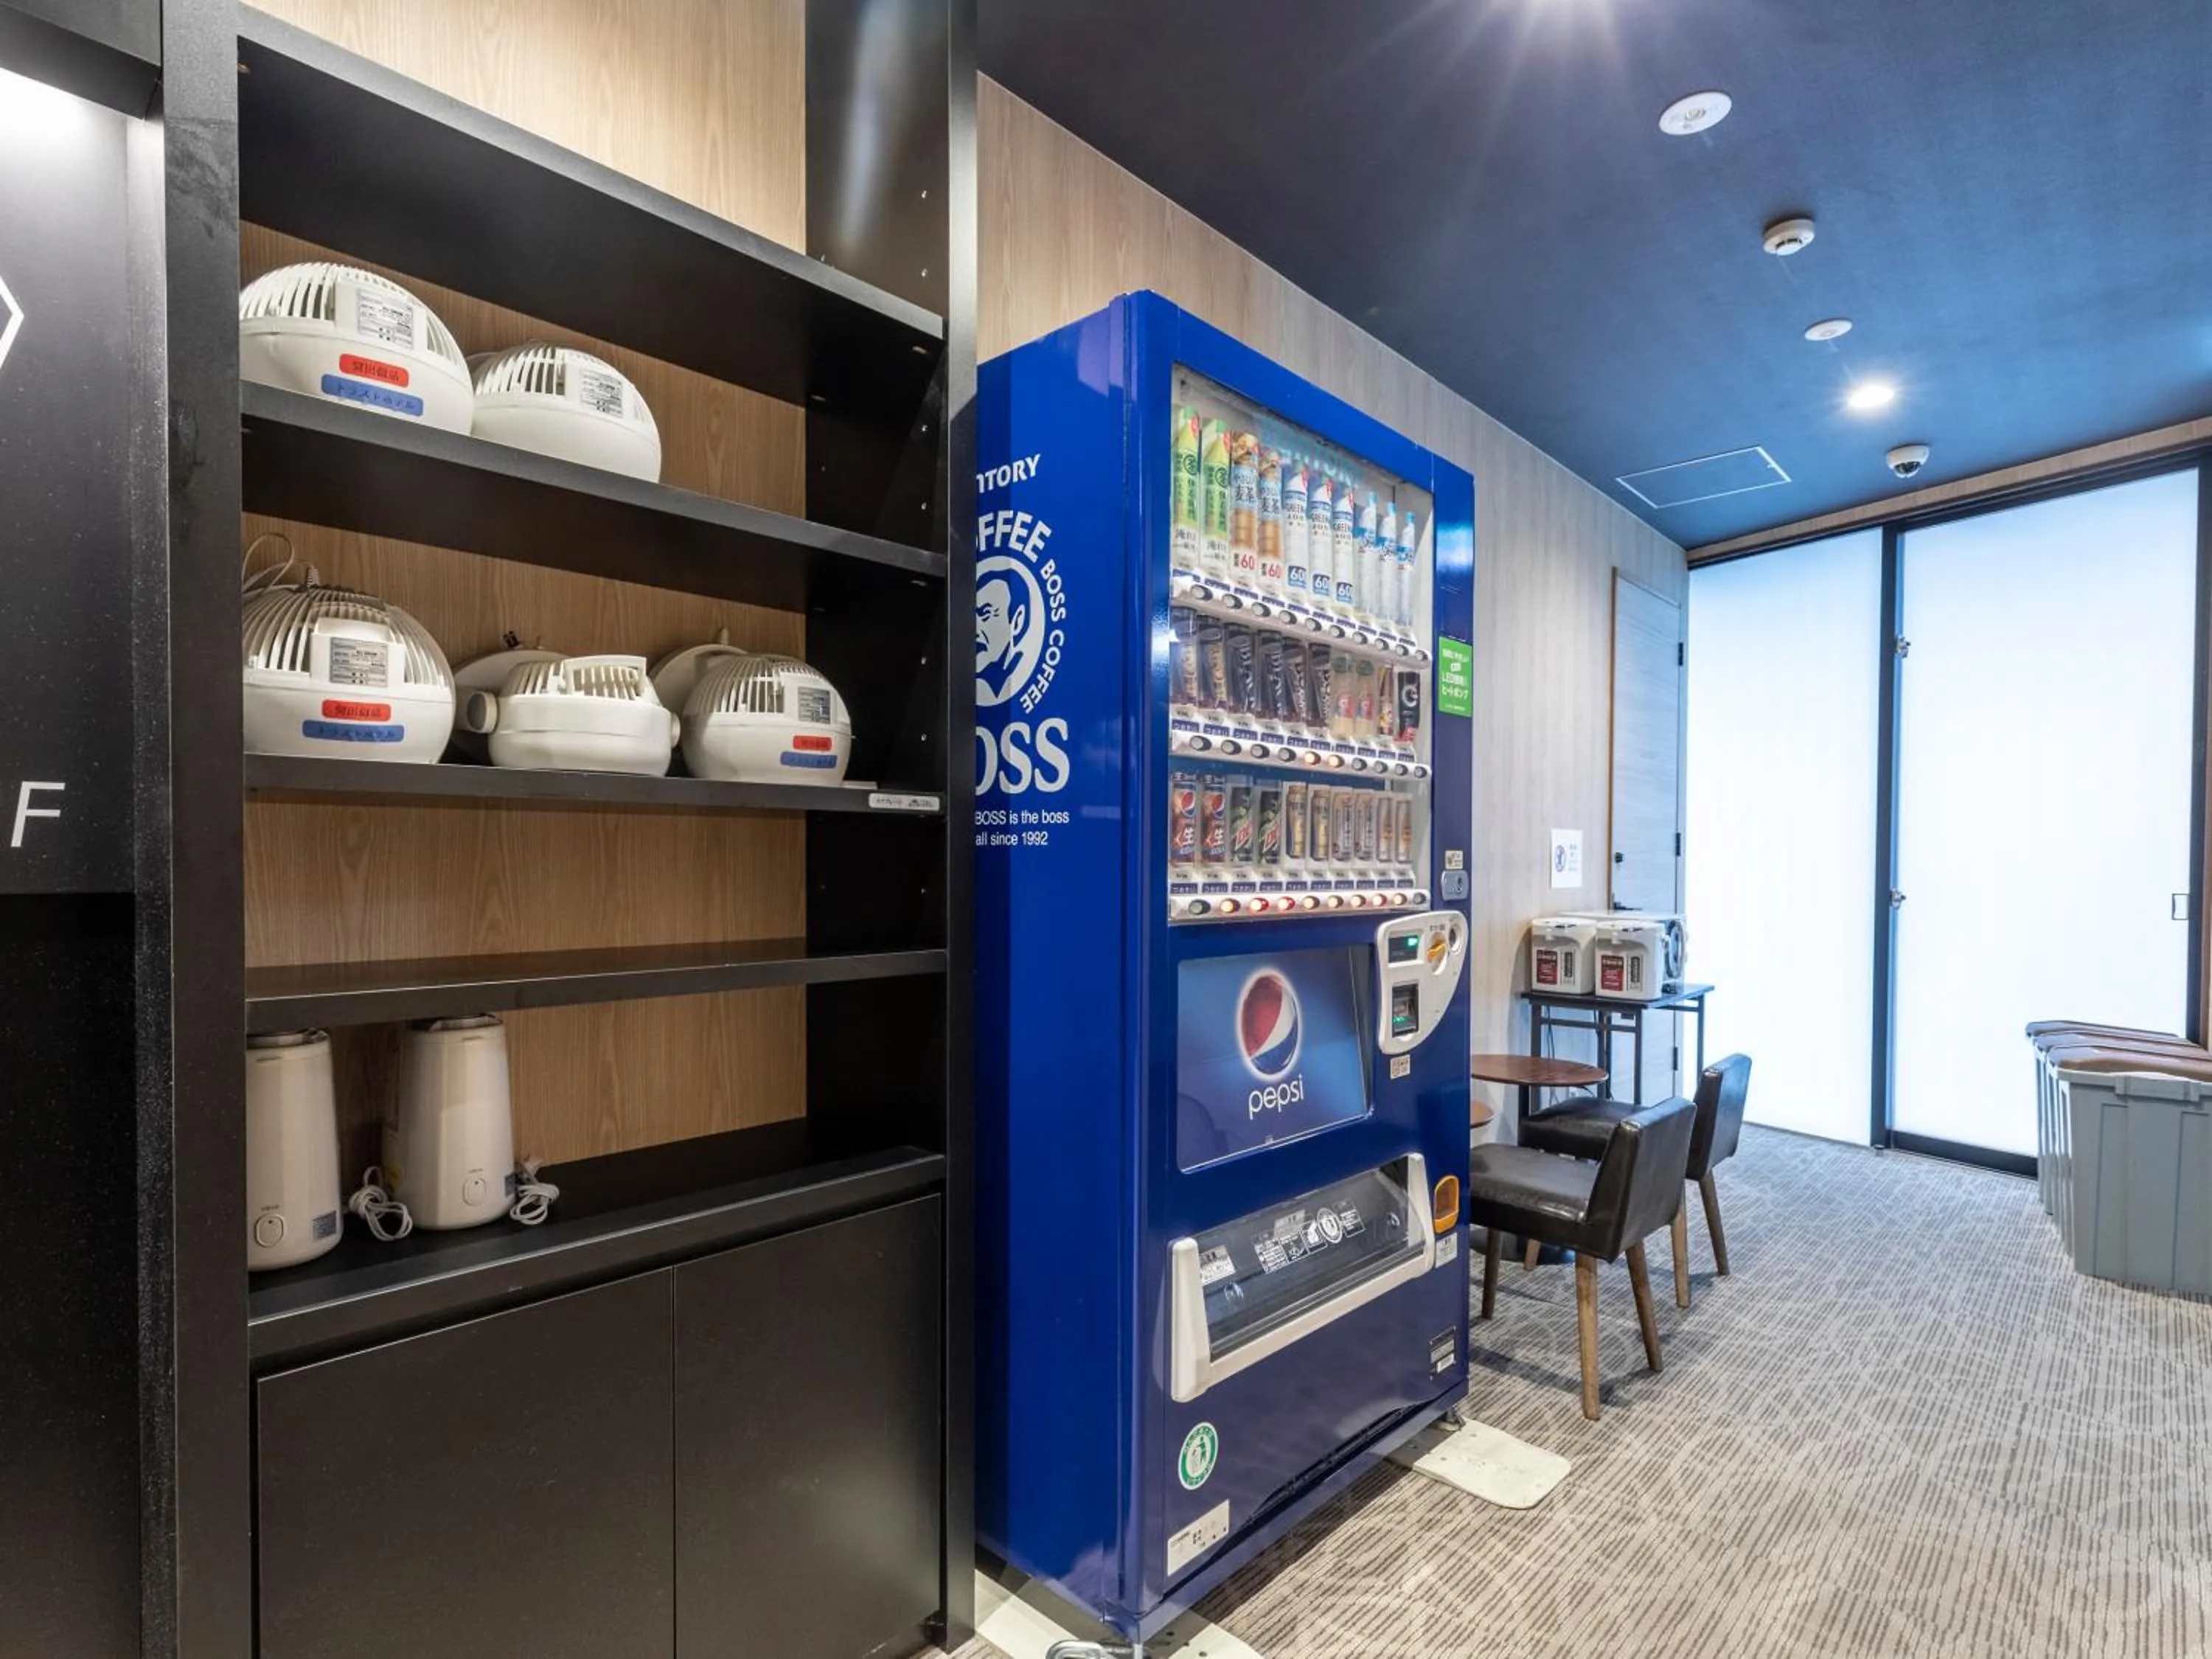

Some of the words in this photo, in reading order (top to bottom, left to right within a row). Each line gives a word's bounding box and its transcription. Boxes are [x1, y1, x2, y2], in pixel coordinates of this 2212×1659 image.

[975, 509, 1052, 563] FFEE
[1040, 558, 1066, 622] BOSS
[1020, 629, 1065, 714] COFFEE
[10, 781, 66, 847] F
[975, 810, 1006, 825] BOSS
[1009, 810, 1018, 824] is
[1021, 810, 1039, 824] the
[1042, 809, 1070, 824] boss
[975, 831, 987, 846] all
[990, 831, 1018, 846] since
[1021, 831, 1048, 846] 1992
[1248, 1074, 1304, 1120] pepsi
